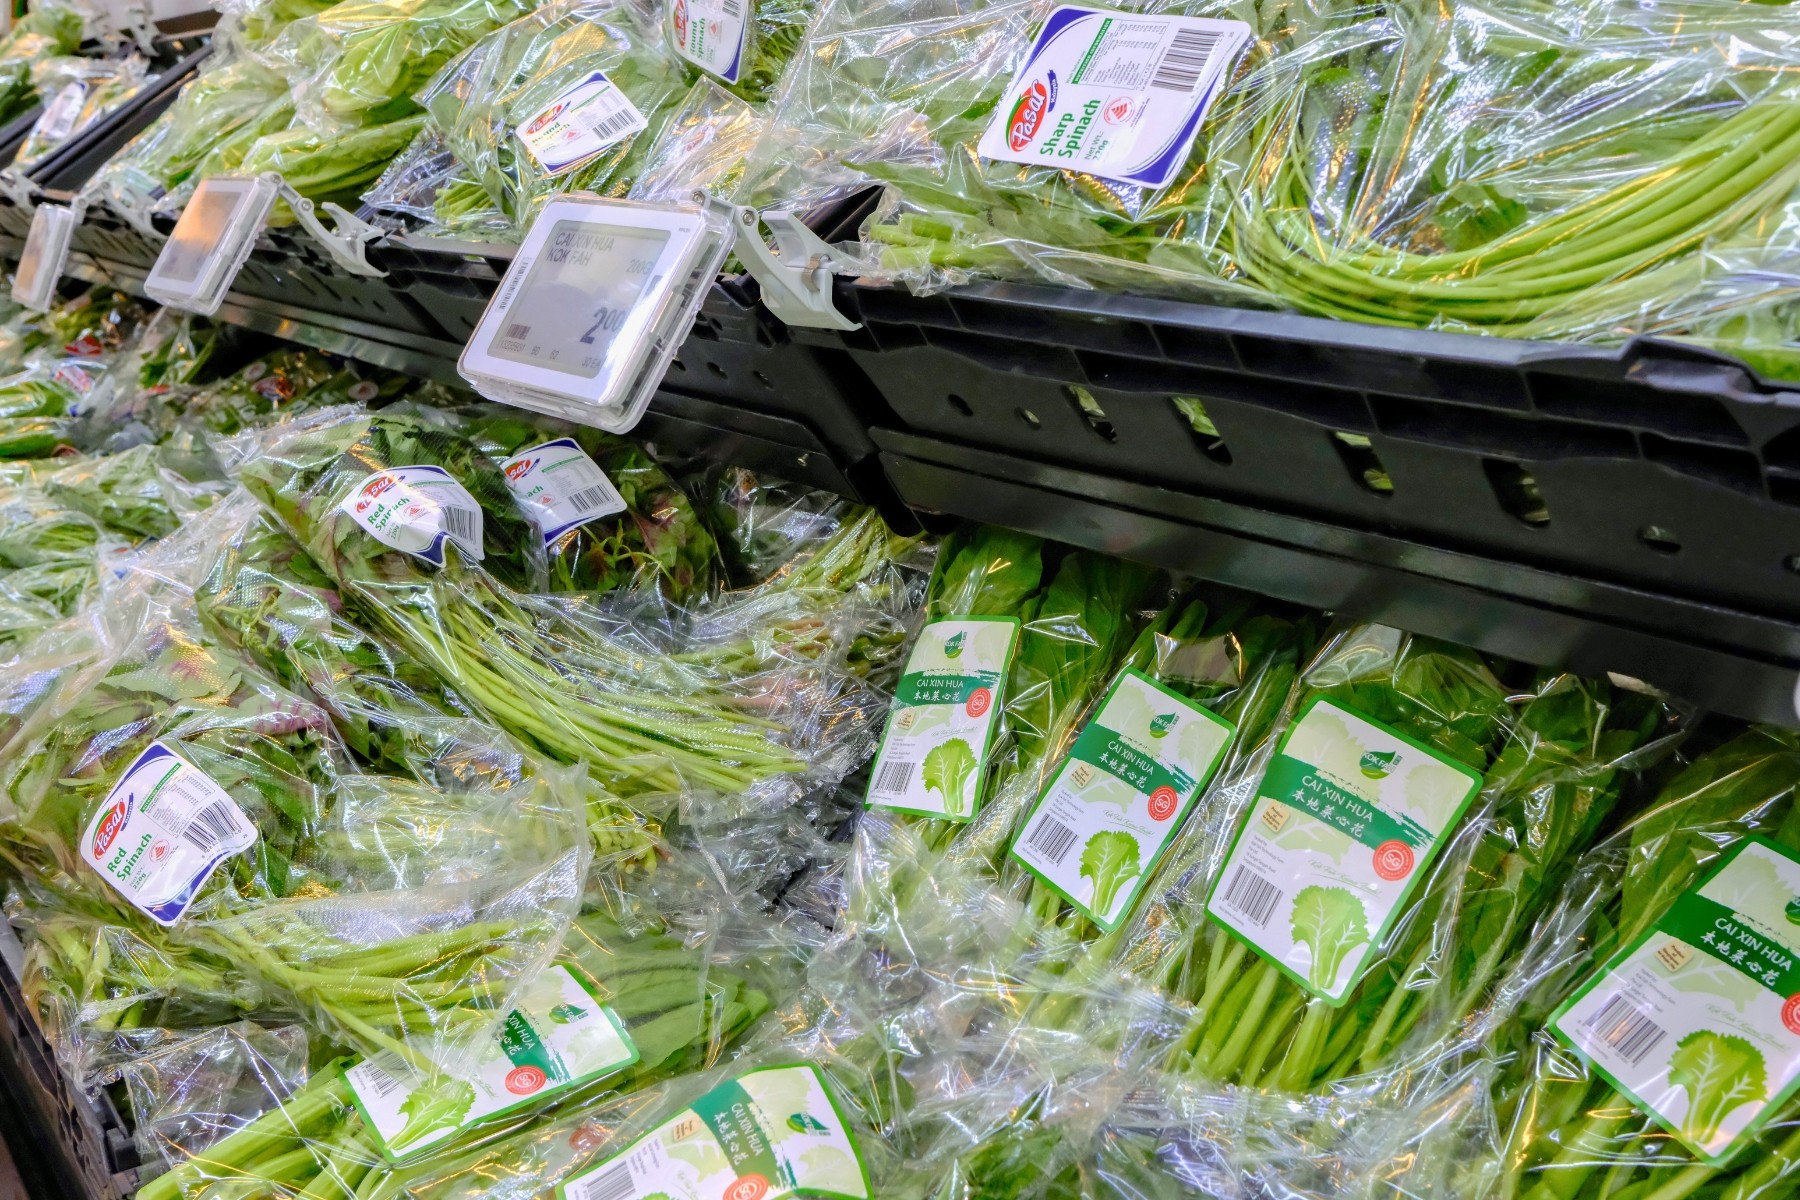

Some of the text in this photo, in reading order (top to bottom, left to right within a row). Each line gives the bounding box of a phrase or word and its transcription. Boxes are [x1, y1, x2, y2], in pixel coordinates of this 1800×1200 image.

[1010, 78, 1049, 148] Pasar
[1058, 99, 1101, 159] Spinach
[1040, 112, 1074, 156] Sharp
[546, 248, 592, 266] KOK FAH
[555, 232, 614, 252] CAI XIN HUA
[367, 504, 385, 524] Red
[914, 690, 960, 701] 本地菜心花
[916, 679, 964, 688] CAI XIN HUA
[1099, 752, 1146, 789] 本地菜心花
[1108, 740, 1154, 775] CAI XIN HUA
[1362, 751, 1380, 767] KOK
[1157, 799, 1168, 809] SG
[1292, 790, 1363, 838] 本地菜心花
[1302, 775, 1373, 822] CAI XIN HUA
[96, 798, 124, 854] Pasar
[107, 848, 126, 873] Red
[116, 832, 152, 882] Spinach
[1386, 854, 1401, 868] SG
[131, 872, 147, 889] 220g
[1700, 931, 1776, 987] 本地菜心花
[1714, 917, 1792, 971] CAI XIN HUA
[508, 1015, 522, 1030] XIN
[517, 1028, 535, 1050] HUA
[520, 1074, 532, 1086] SG
[714, 1111, 748, 1165] 本地菜心花
[732, 1102, 764, 1156] CAI XIN HUA
